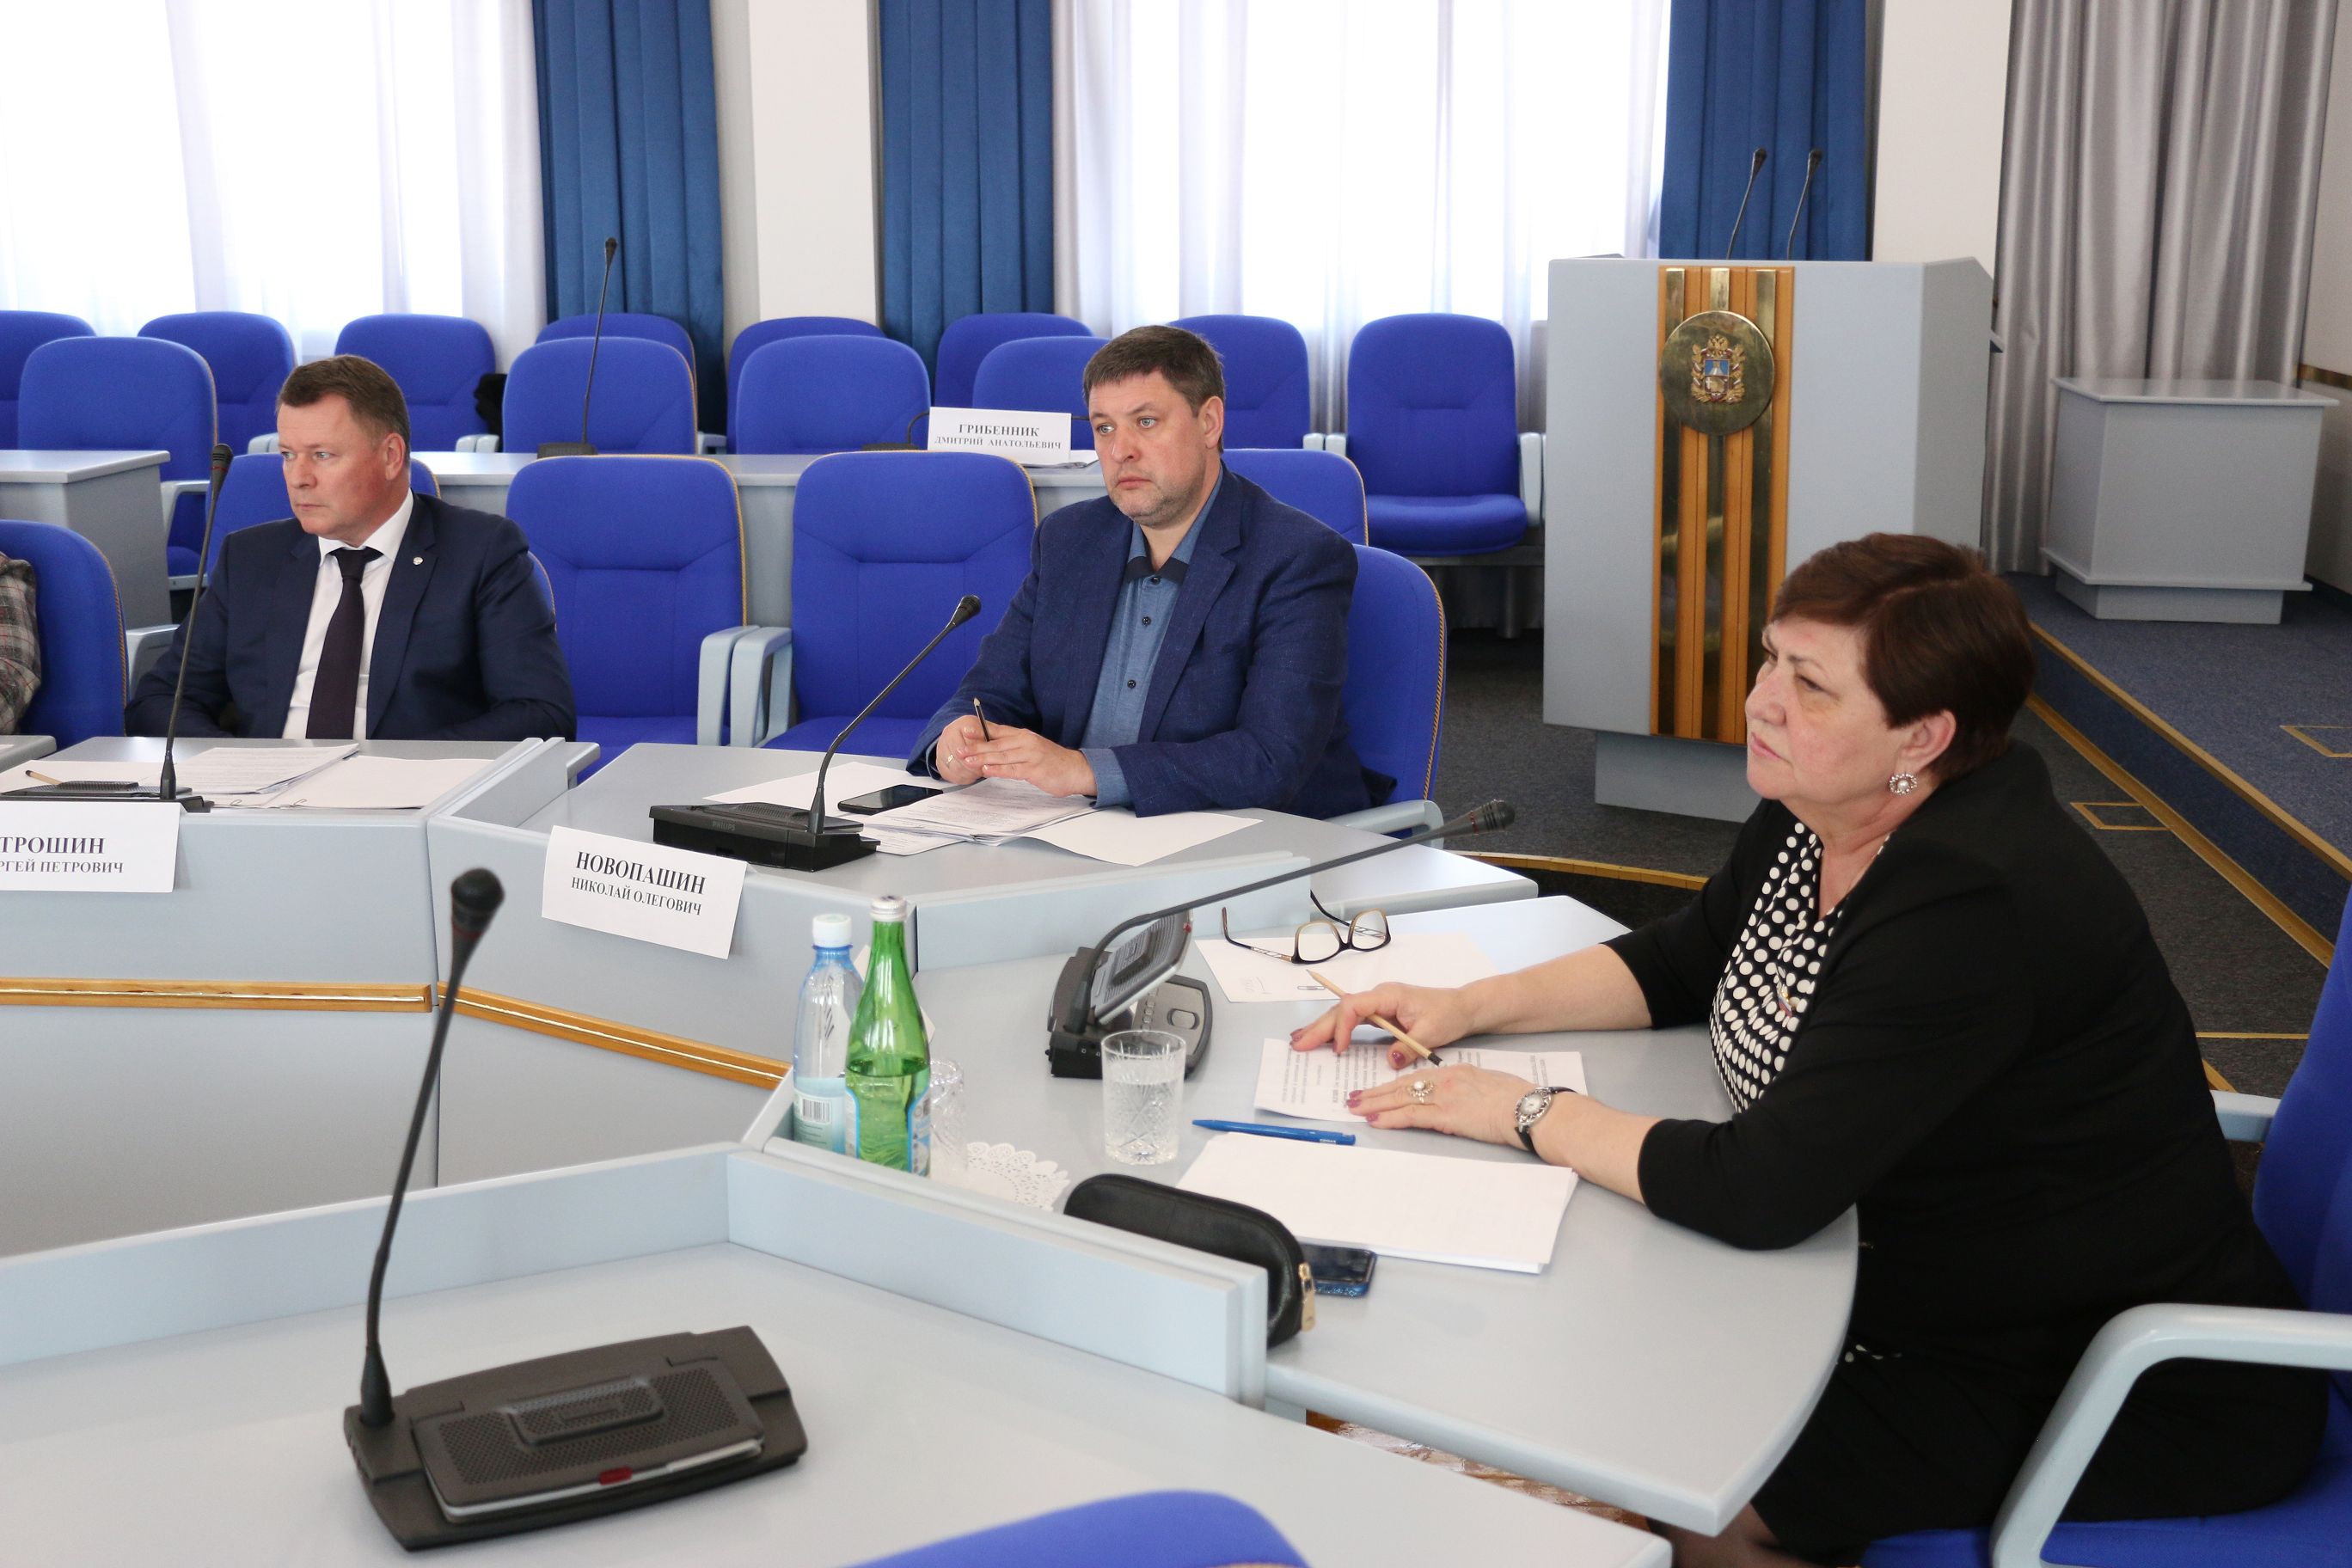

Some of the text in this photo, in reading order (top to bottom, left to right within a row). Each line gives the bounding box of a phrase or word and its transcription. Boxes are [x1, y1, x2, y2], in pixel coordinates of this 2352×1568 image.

[959, 424, 1039, 437] ГРИБЕННИК
[934, 436, 1062, 450] ДМИТРИЙ АНАТОЛЬЕВИЧ
[0, 836, 106, 854] ТРОШИН
[40, 861, 124, 873] ПЕТРОВИЧ
[575, 851, 707, 895] НОВОПАШИН
[571, 876, 702, 916] НИКОЛАЙ ОЛЕГОВИЧ
